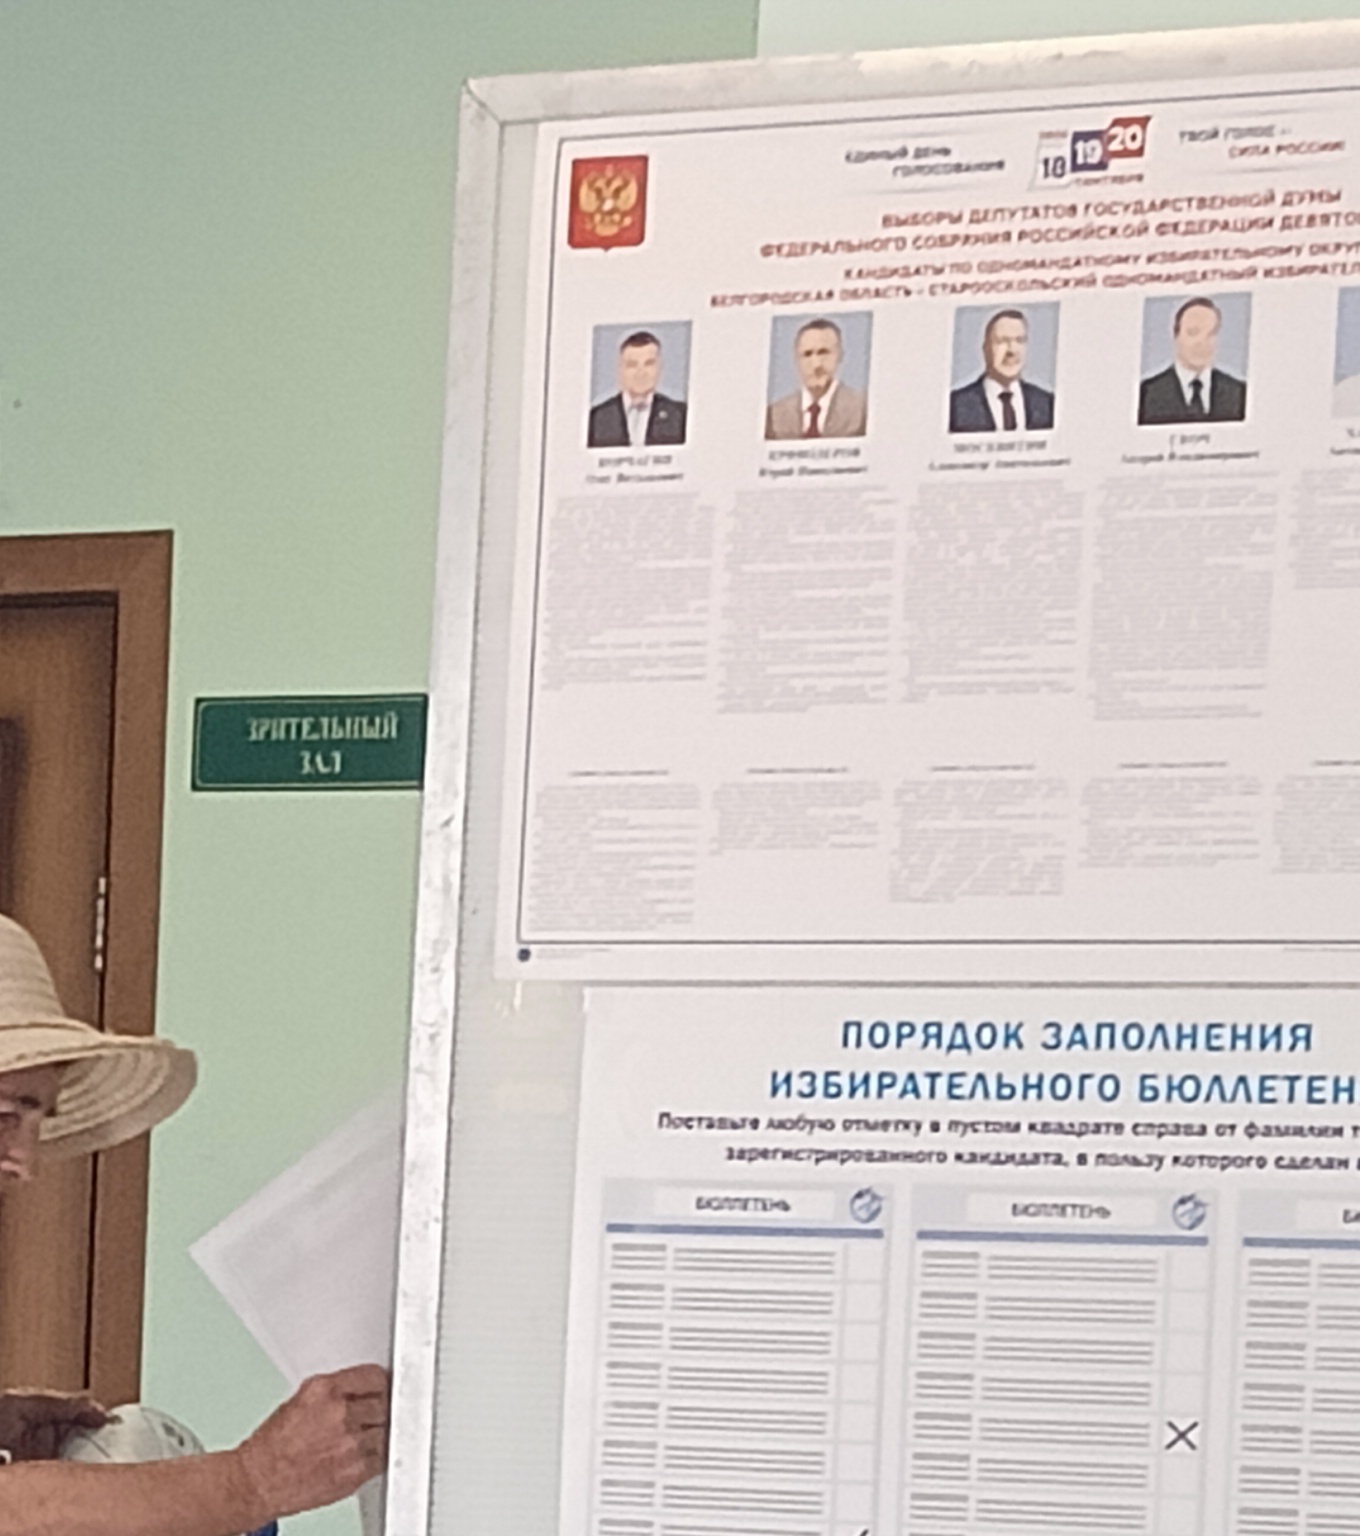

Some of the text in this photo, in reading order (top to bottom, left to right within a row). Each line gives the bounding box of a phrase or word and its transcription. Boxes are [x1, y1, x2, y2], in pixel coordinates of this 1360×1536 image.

[1107, 124, 1142, 151] 20
[882, 189, 1342, 228] ВЫБОРЫ ДЕПУТАТОВ ГОСУДАРСТВЕННОЙ ДУМЫ
[760, 236, 906, 258] ФЕДЕРАЛЬНОГО
[912, 230, 1012, 250] СОБРАНИЯ
[1018, 221, 1149, 244] РОССИЙСКОЙ
[1156, 215, 1274, 239] ФЕДЕРАЦИИ
[247, 710, 398, 742] ЗРИТЕЛЬНЫЙ
[841, 1021, 1314, 1055] ПОРЯДОК ЗАПОЛНЕНИЯ
[769, 1069, 1356, 1105] ИЗБИРАТЕЛЬНОГО БЮЛЛЕТЕН
[657, 1111, 761, 1132] Поставьте
[766, 1113, 836, 1136] любую
[841, 1117, 923, 1138] отметку
[947, 1119, 1021, 1138] пустом
[1027, 1121, 1126, 1139] квадрате
[1131, 1121, 1208, 1139] справа
[1214, 1123, 1237, 1137] от
[725, 1146, 948, 1166] зарегистрированного
[1094, 1154, 1166, 1172] пользу
[1171, 1154, 1268, 1172] которого
[1274, 1155, 1350, 1170] сделан
